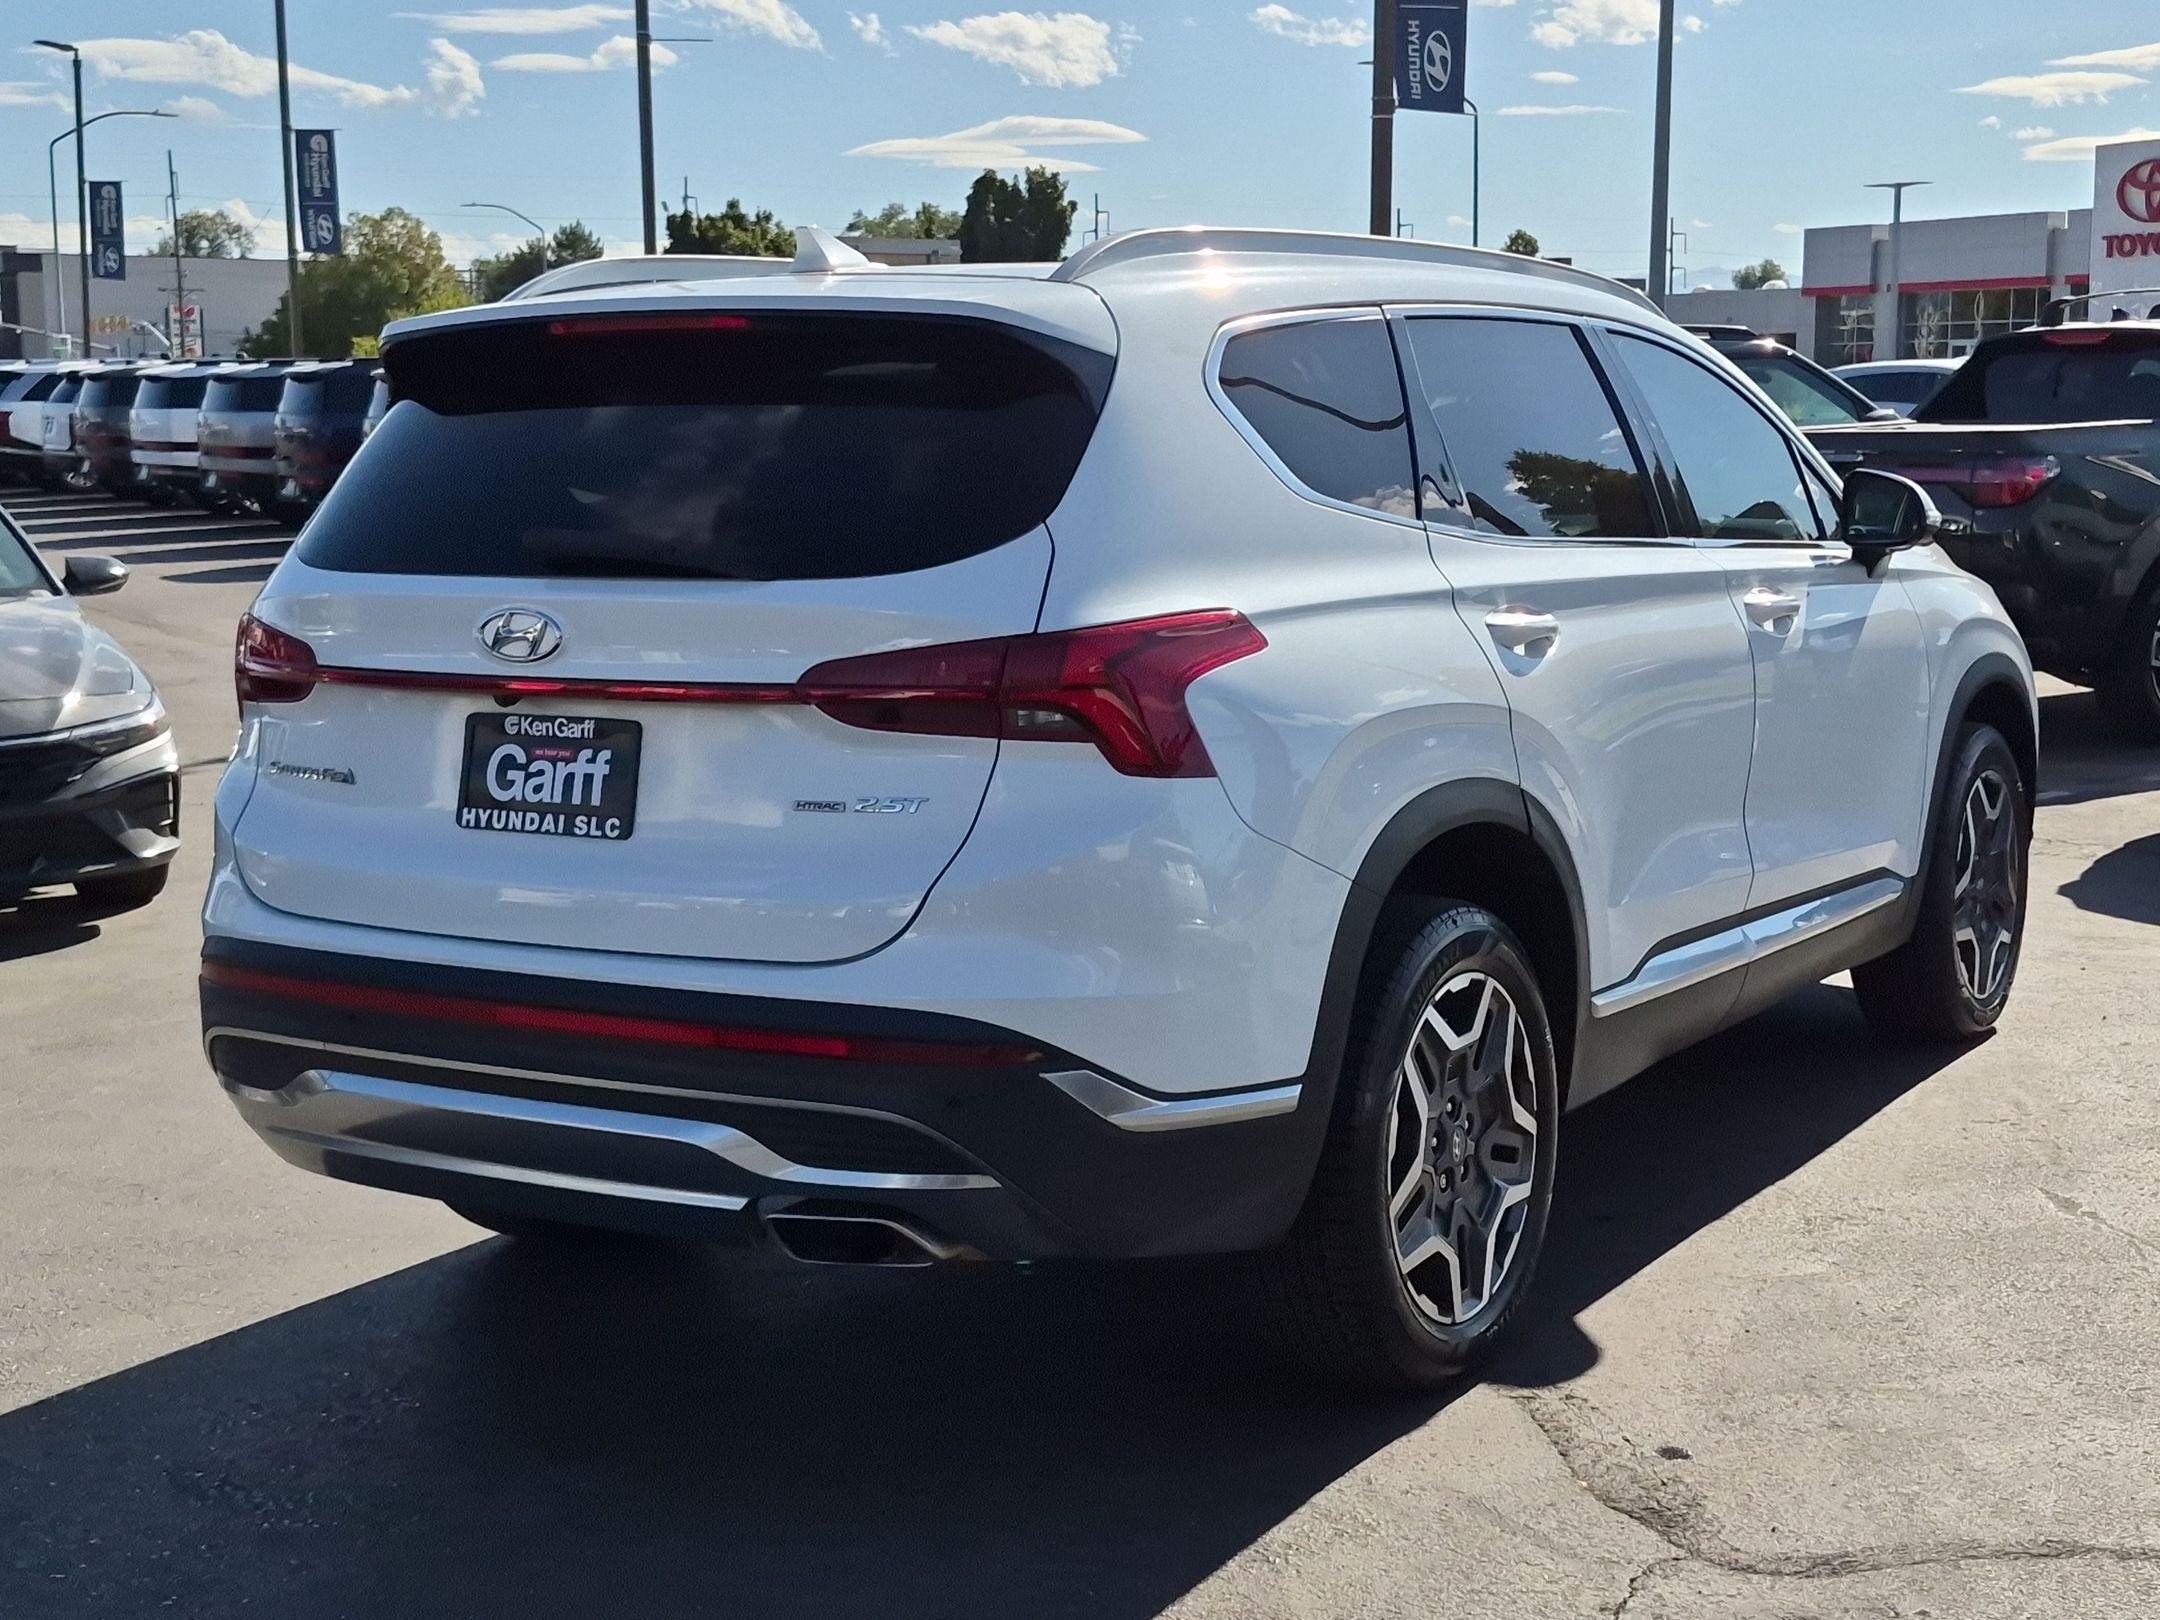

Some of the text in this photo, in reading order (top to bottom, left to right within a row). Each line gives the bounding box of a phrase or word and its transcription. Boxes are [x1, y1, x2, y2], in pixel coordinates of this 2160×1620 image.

[1408, 20, 1421, 99] HYUNDAI
[486, 743, 612, 807] Garff
[462, 807, 621, 838] HYUNDAI SLC
